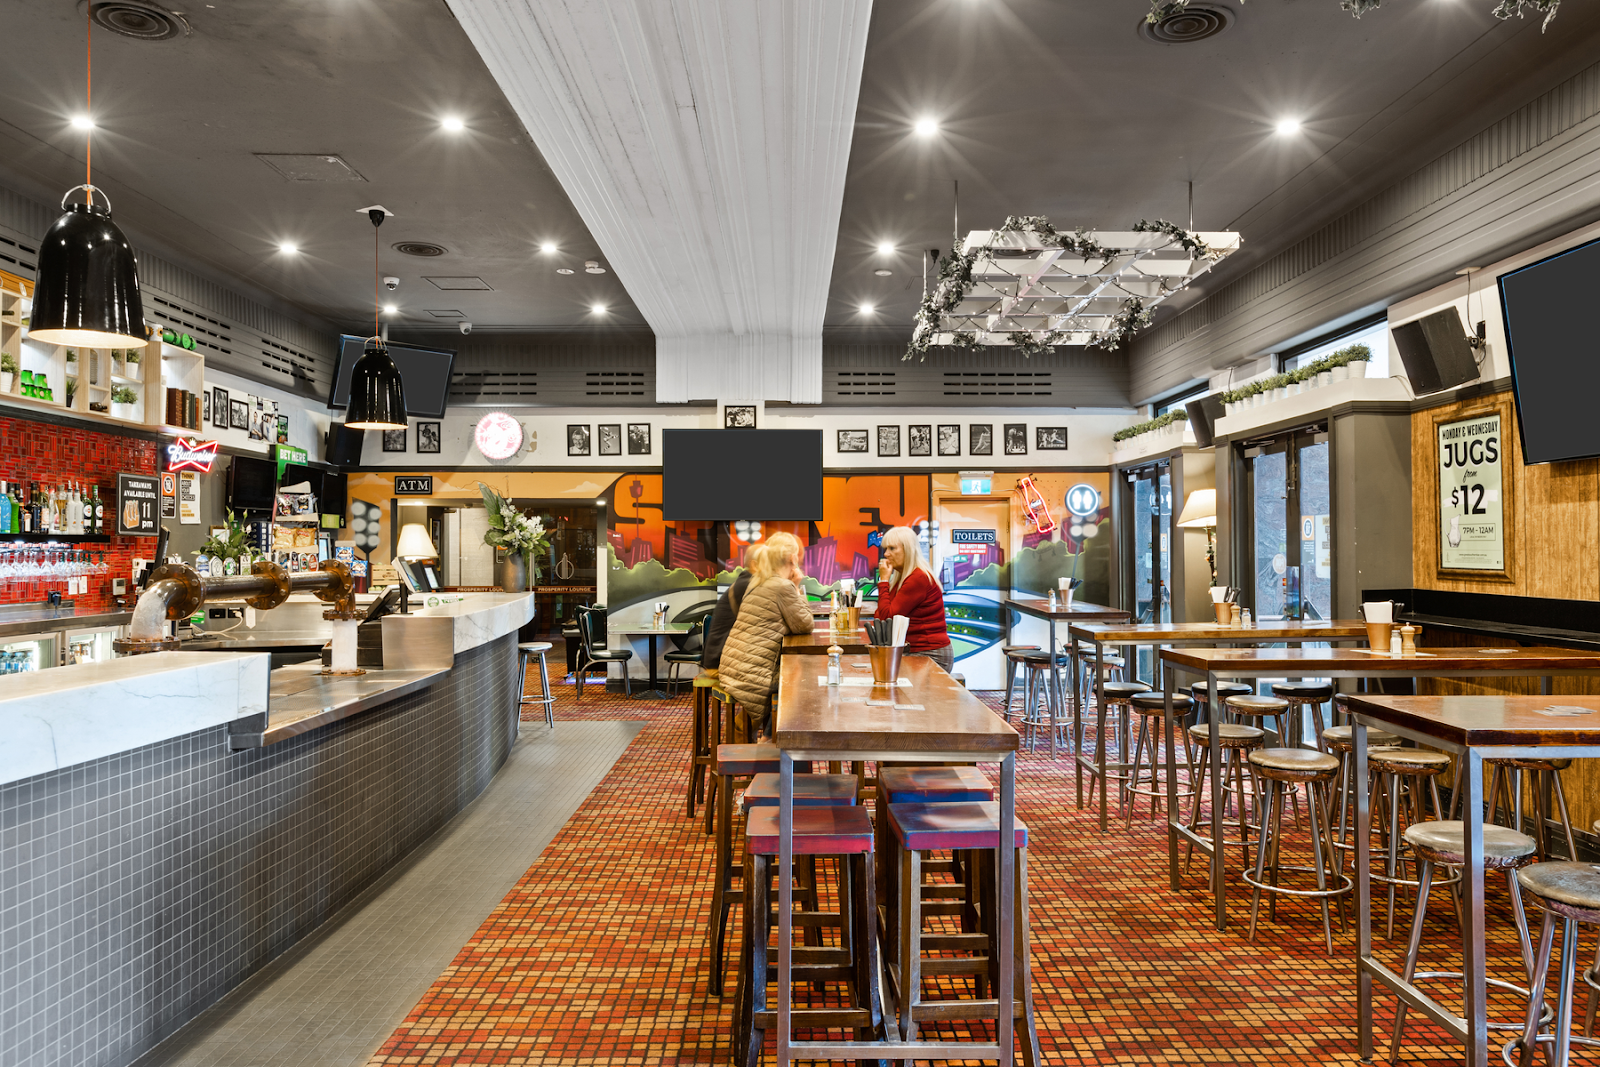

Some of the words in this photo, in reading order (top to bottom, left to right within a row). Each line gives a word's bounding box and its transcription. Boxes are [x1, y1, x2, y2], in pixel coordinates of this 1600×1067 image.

[1442, 426, 1461, 440] MONDAY
[1462, 426, 1466, 437] &
[1466, 421, 1498, 436] WEDNESDAY
[167, 445, 217, 463] Budweiser
[280, 448, 292, 461] BET
[292, 451, 306, 463] HERE
[1443, 437, 1498, 468] JUGS
[1463, 469, 1477, 483] from
[128, 481, 152, 489] TAKEAWAYS
[398, 480, 429, 490] ATM
[124, 490, 145, 498] AVAILABLE
[145, 491, 156, 499] UNTIL
[1451, 484, 1486, 515] $12
[142, 502, 151, 518] 11
[142, 520, 153, 529] pm
[955, 532, 994, 540] TOILETS
